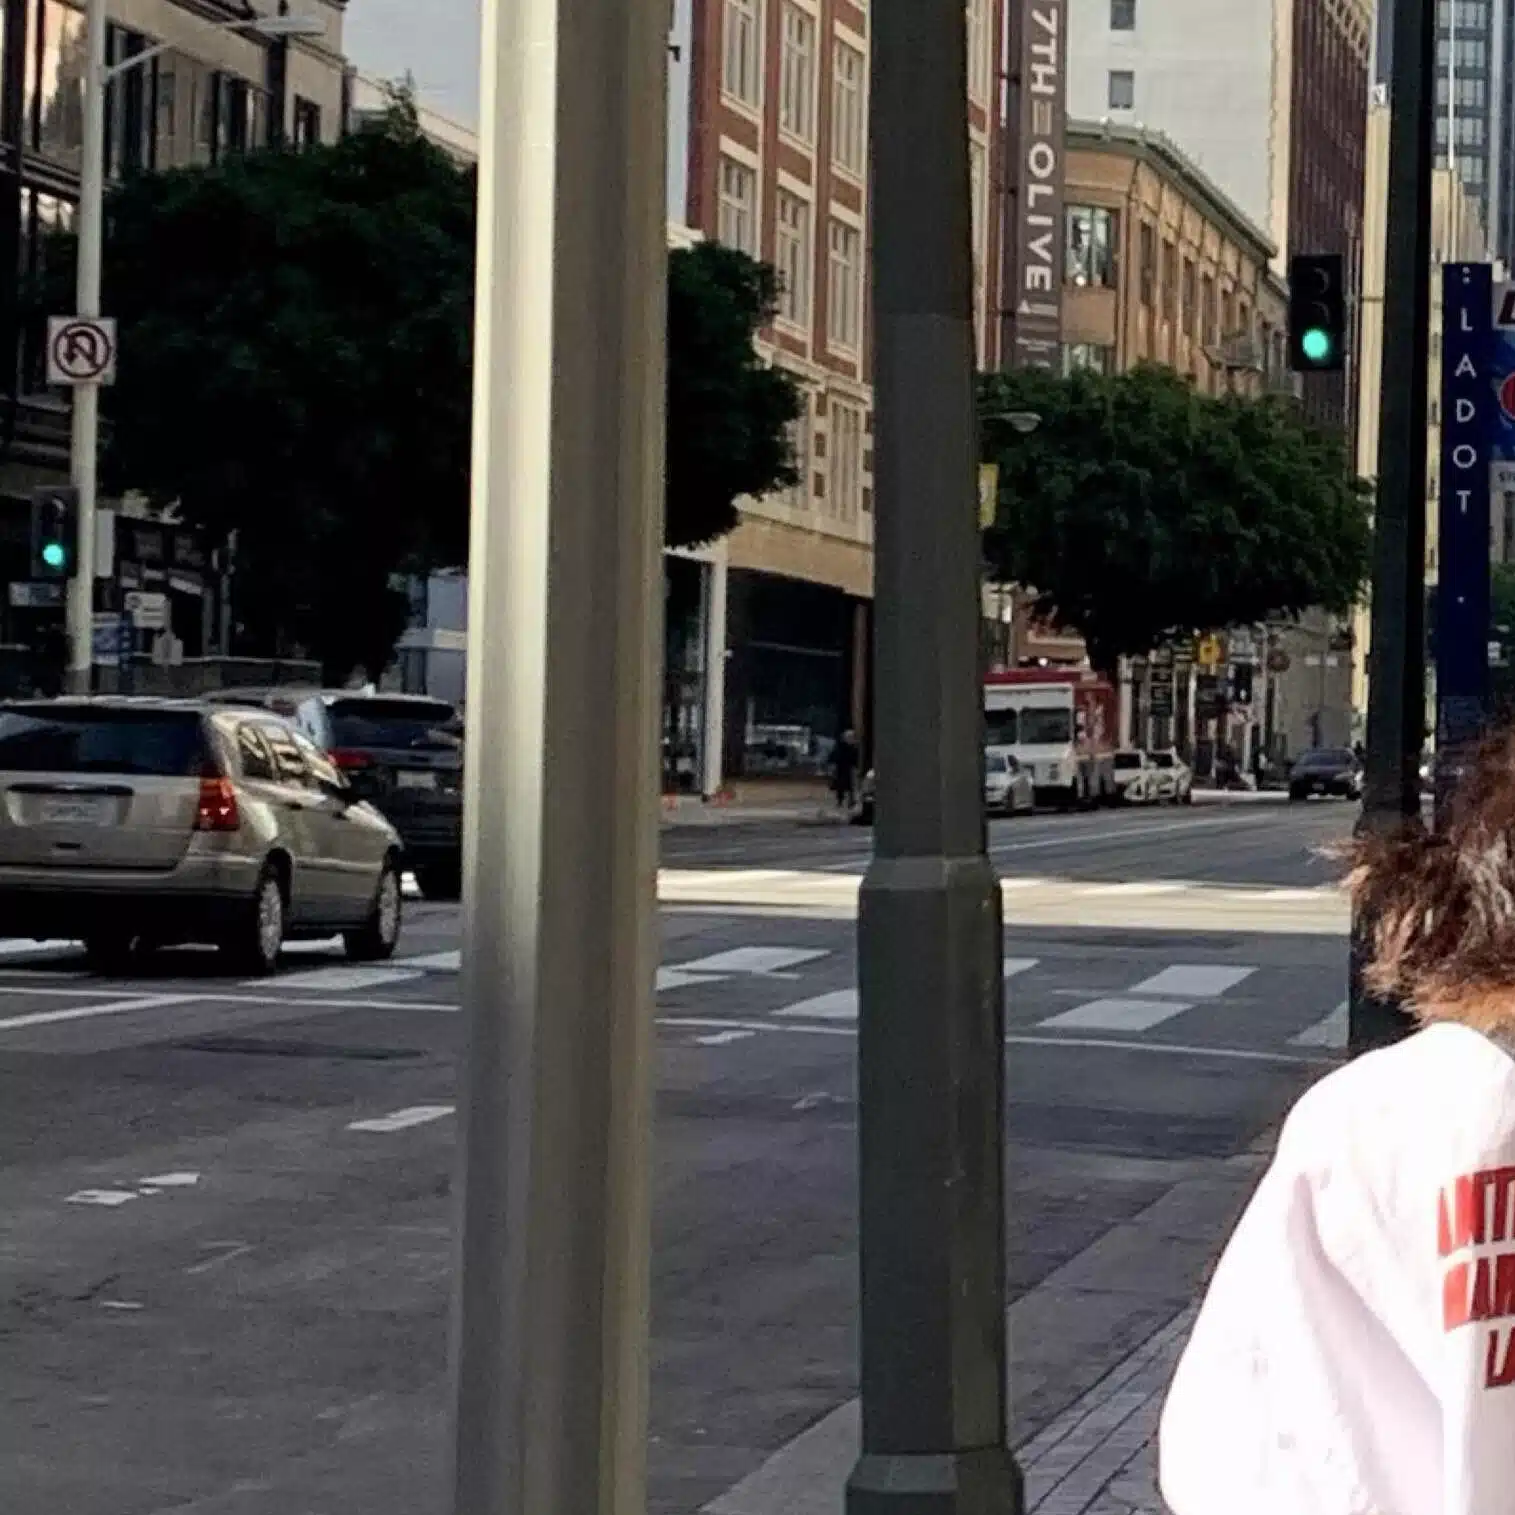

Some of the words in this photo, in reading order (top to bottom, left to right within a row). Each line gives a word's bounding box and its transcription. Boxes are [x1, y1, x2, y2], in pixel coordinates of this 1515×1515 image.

[1031, 8, 1057, 95] 7TH
[1025, 141, 1056, 291] OLIVE
[1452, 307, 1478, 514] LADOT
